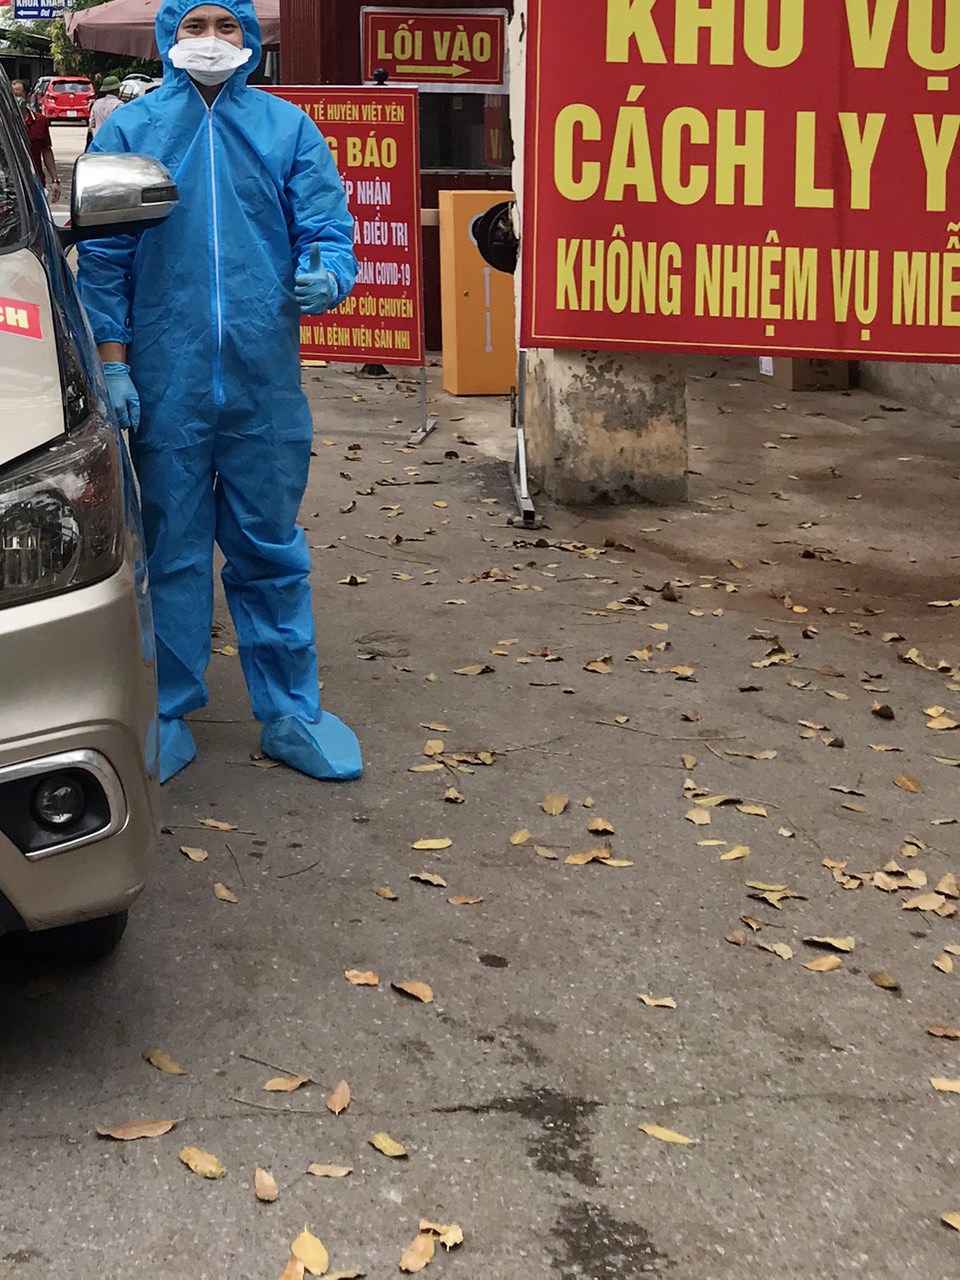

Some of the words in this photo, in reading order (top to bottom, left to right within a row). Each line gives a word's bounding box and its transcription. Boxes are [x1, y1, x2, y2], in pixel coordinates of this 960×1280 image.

[377, 20, 423, 61] LỐI
[433, 25, 491, 62] VÀO
[313, 98, 325, 120] TẾ
[327, 101, 359, 124] HUYỆN
[362, 101, 382, 124] VIỆT
[385, 102, 404, 121] YÊN
[347, 131, 397, 168] BÁO
[553, 85, 764, 207] CÁCH
[794, 112, 886, 210] LY
[357, 176, 391, 210] NHẬN
[363, 213, 388, 245] ĐIỀU
[391, 222, 408, 251] TRỊ
[376, 261, 411, 286] COVID-19
[556, 224, 682, 316] KHÔNG
[695, 230, 818, 337] NHIỆM
[831, 249, 879, 341] VỤ
[359, 292, 376, 316] CỨU
[379, 291, 413, 318] CHUYỂN
[314, 323, 326, 345] VÀ
[327, 323, 350, 350] BỆNH
[352, 324, 372, 351] VIỆN
[375, 321, 392, 349] SẢN
[395, 330, 410, 349] NHI
